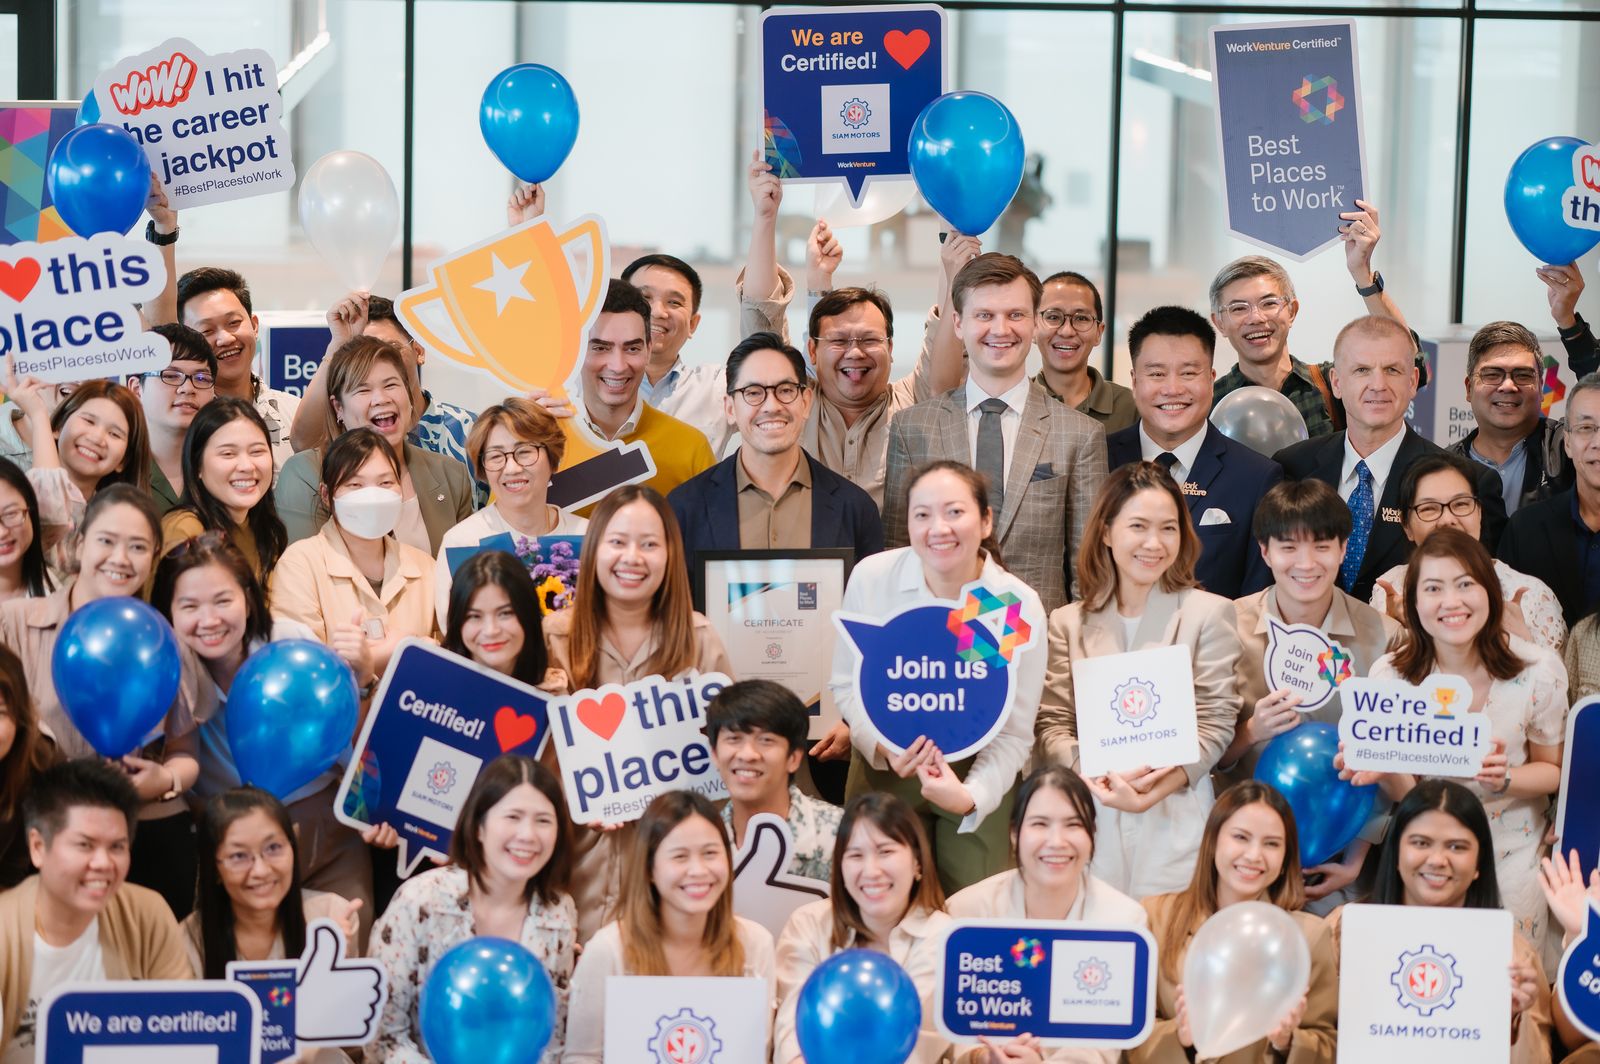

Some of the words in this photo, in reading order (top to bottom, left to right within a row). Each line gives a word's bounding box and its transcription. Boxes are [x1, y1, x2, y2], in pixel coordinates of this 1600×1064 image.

[791, 29, 824, 47] We
[830, 30, 864, 46] are
[1226, 41, 1291, 54] WorkVenture
[780, 51, 877, 72] Certified!
[204, 70, 216, 96] I
[223, 63, 265, 93] hit
[123, 122, 163, 145] he
[172, 102, 270, 139] career
[832, 132, 850, 140] SIAM
[850, 131, 881, 140] MOTORS
[1248, 133, 1302, 157] Best
[161, 135, 279, 185] jackpot
[837, 160, 876, 169] WorkVenture
[174, 168, 283, 197] #BestPlacestoWork
[1250, 162, 1327, 185] Places
[1251, 190, 1277, 213] to
[1570, 195, 1600, 223] th
[47, 248, 150, 295] this
[11, 345, 157, 375] #BestPlacestoWork
[284, 354, 318, 380] Be
[1449, 406, 1474, 421] Bes
[1448, 424, 1472, 438] Pla
[1183, 488, 1207, 496] enture
[744, 619, 804, 628] CERTIFICATE
[1288, 644, 1313, 662] Join
[886, 655, 946, 679] Join
[954, 660, 988, 679] us
[1284, 659, 1305, 673] our
[1280, 670, 1314, 692] team!
[887, 688, 966, 712] soon!
[1353, 691, 1427, 715] We're
[398, 689, 487, 742] Certified!
[558, 705, 575, 748] I
[1100, 733, 1128, 748] SIAM
[1129, 728, 1178, 744] MOTORS
[1352, 718, 1465, 747] Certified
[1355, 748, 1471, 766] #BestPlacestoWork
[572, 742, 710, 814] place
[958, 952, 1004, 973] Best
[957, 974, 1022, 995] Places
[956, 997, 978, 1016] to
[981, 996, 1033, 1017] Work
[66, 1010, 102, 1035] We
[107, 1015, 140, 1034] are
[146, 1010, 237, 1034] certified!
[1369, 1023, 1409, 1037] SIAM
[1412, 1026, 1482, 1041] MOTORS
